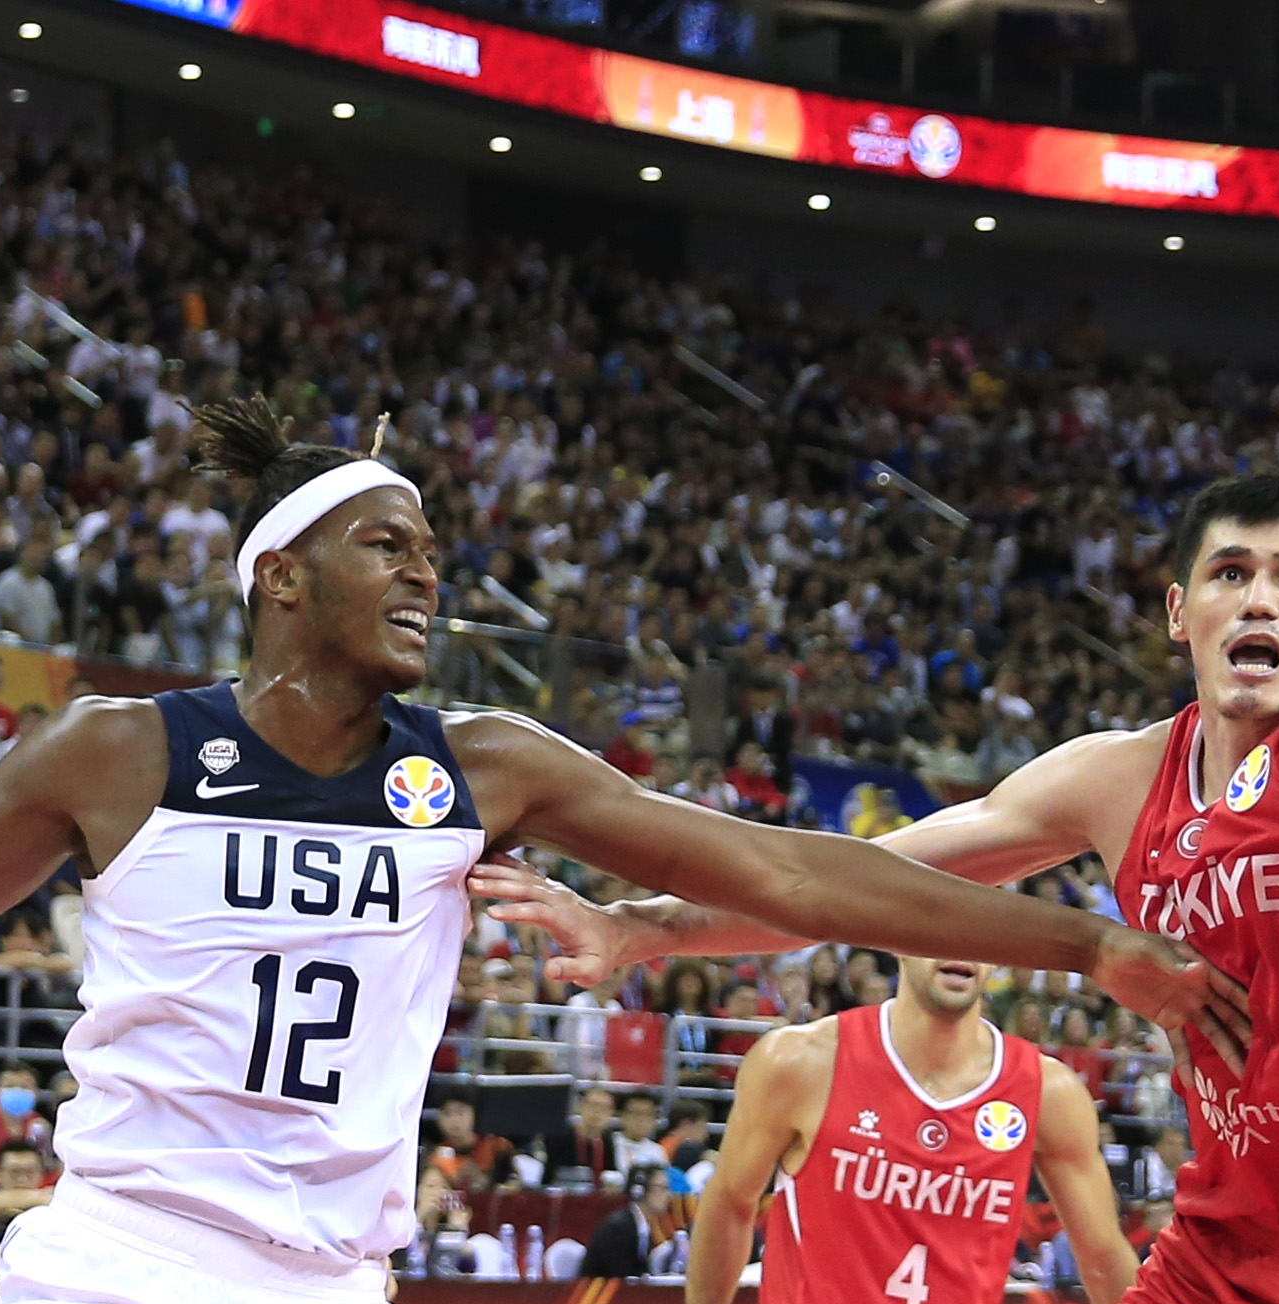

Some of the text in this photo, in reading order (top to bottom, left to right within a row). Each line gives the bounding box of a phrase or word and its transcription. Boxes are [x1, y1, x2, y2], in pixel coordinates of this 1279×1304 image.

[224, 832, 400, 923] USA
[244, 953, 360, 1105] 12
[830, 1146, 1016, 1224] TÜRKİYE
